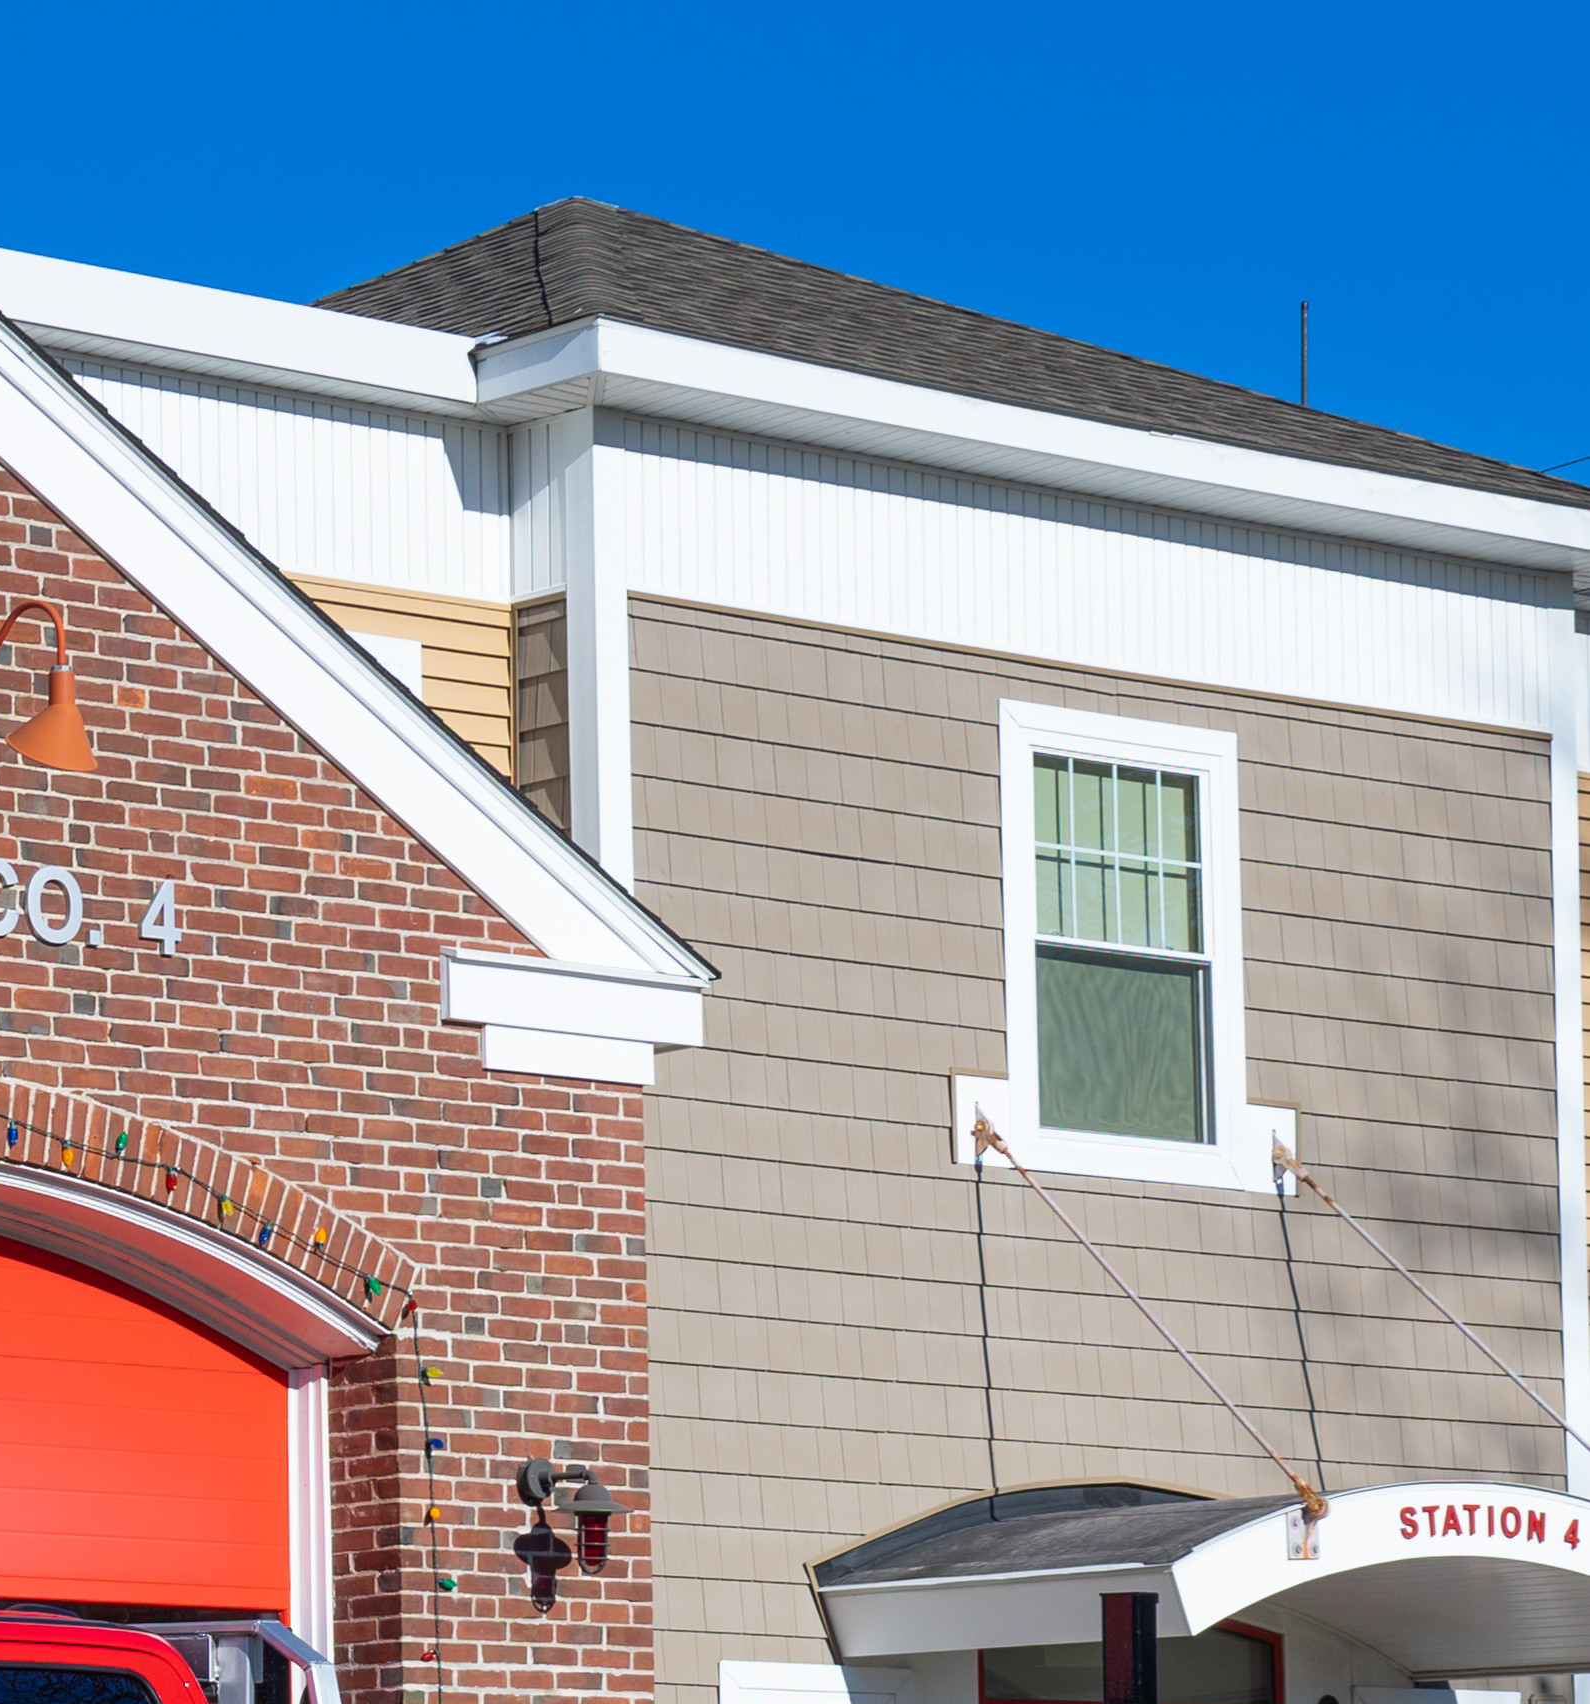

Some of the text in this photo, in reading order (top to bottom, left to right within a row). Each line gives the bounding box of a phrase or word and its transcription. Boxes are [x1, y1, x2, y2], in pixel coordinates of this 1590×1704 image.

[139, 880, 183, 957] 4
[1400, 1504, 1581, 1550] STATION 4
